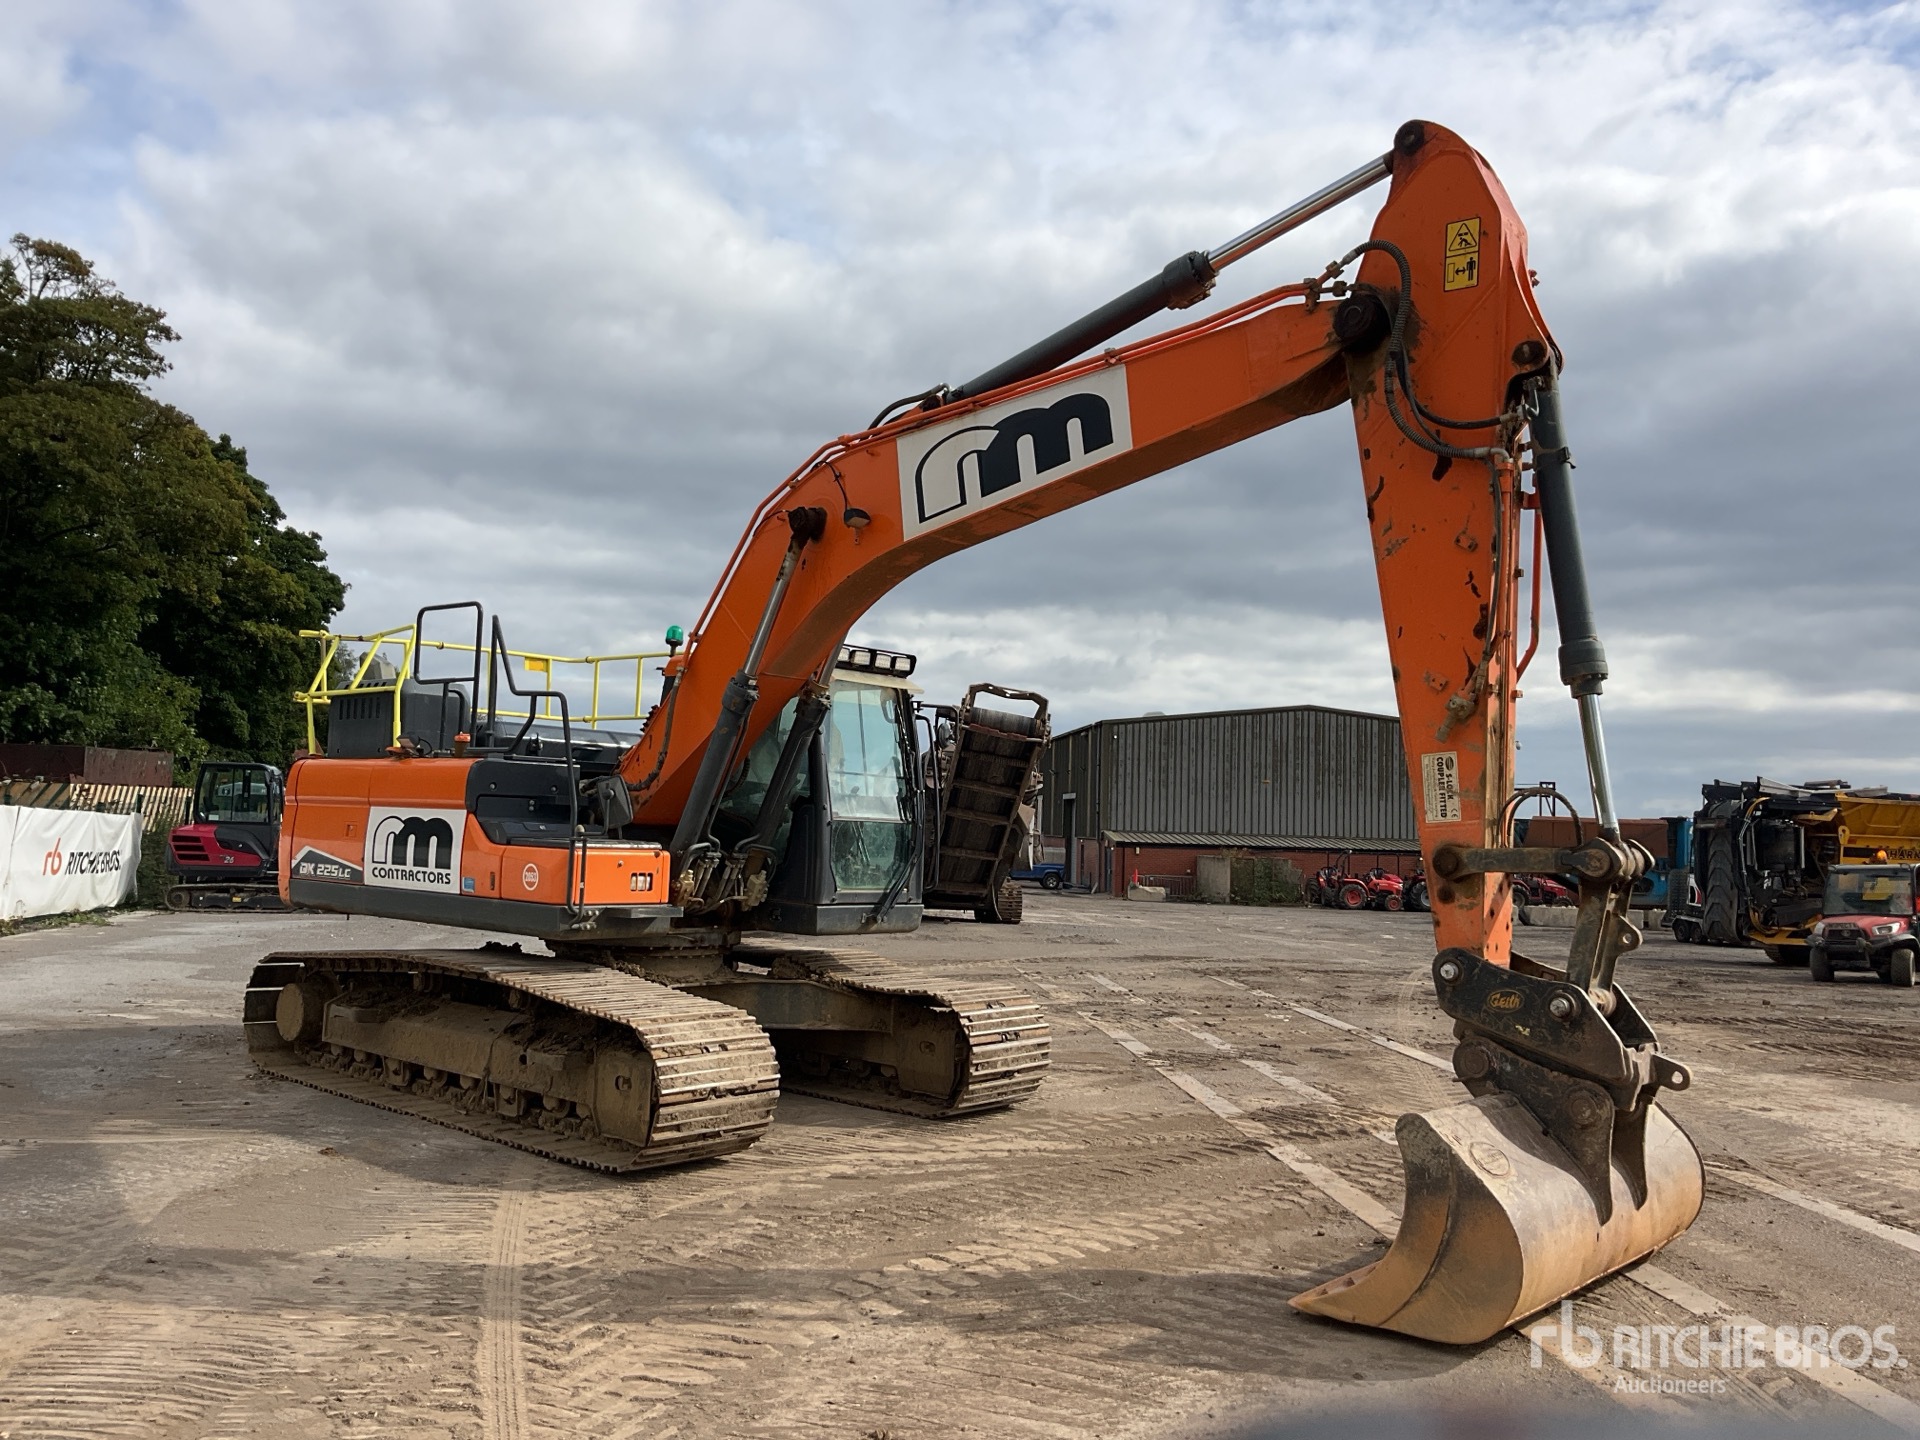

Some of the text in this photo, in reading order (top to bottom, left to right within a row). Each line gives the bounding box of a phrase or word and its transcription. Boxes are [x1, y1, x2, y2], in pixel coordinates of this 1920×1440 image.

[1439, 792, 1447, 818] FITTED
[300, 862, 315, 875] DX
[372, 867, 451, 885] CONTRACTORS
